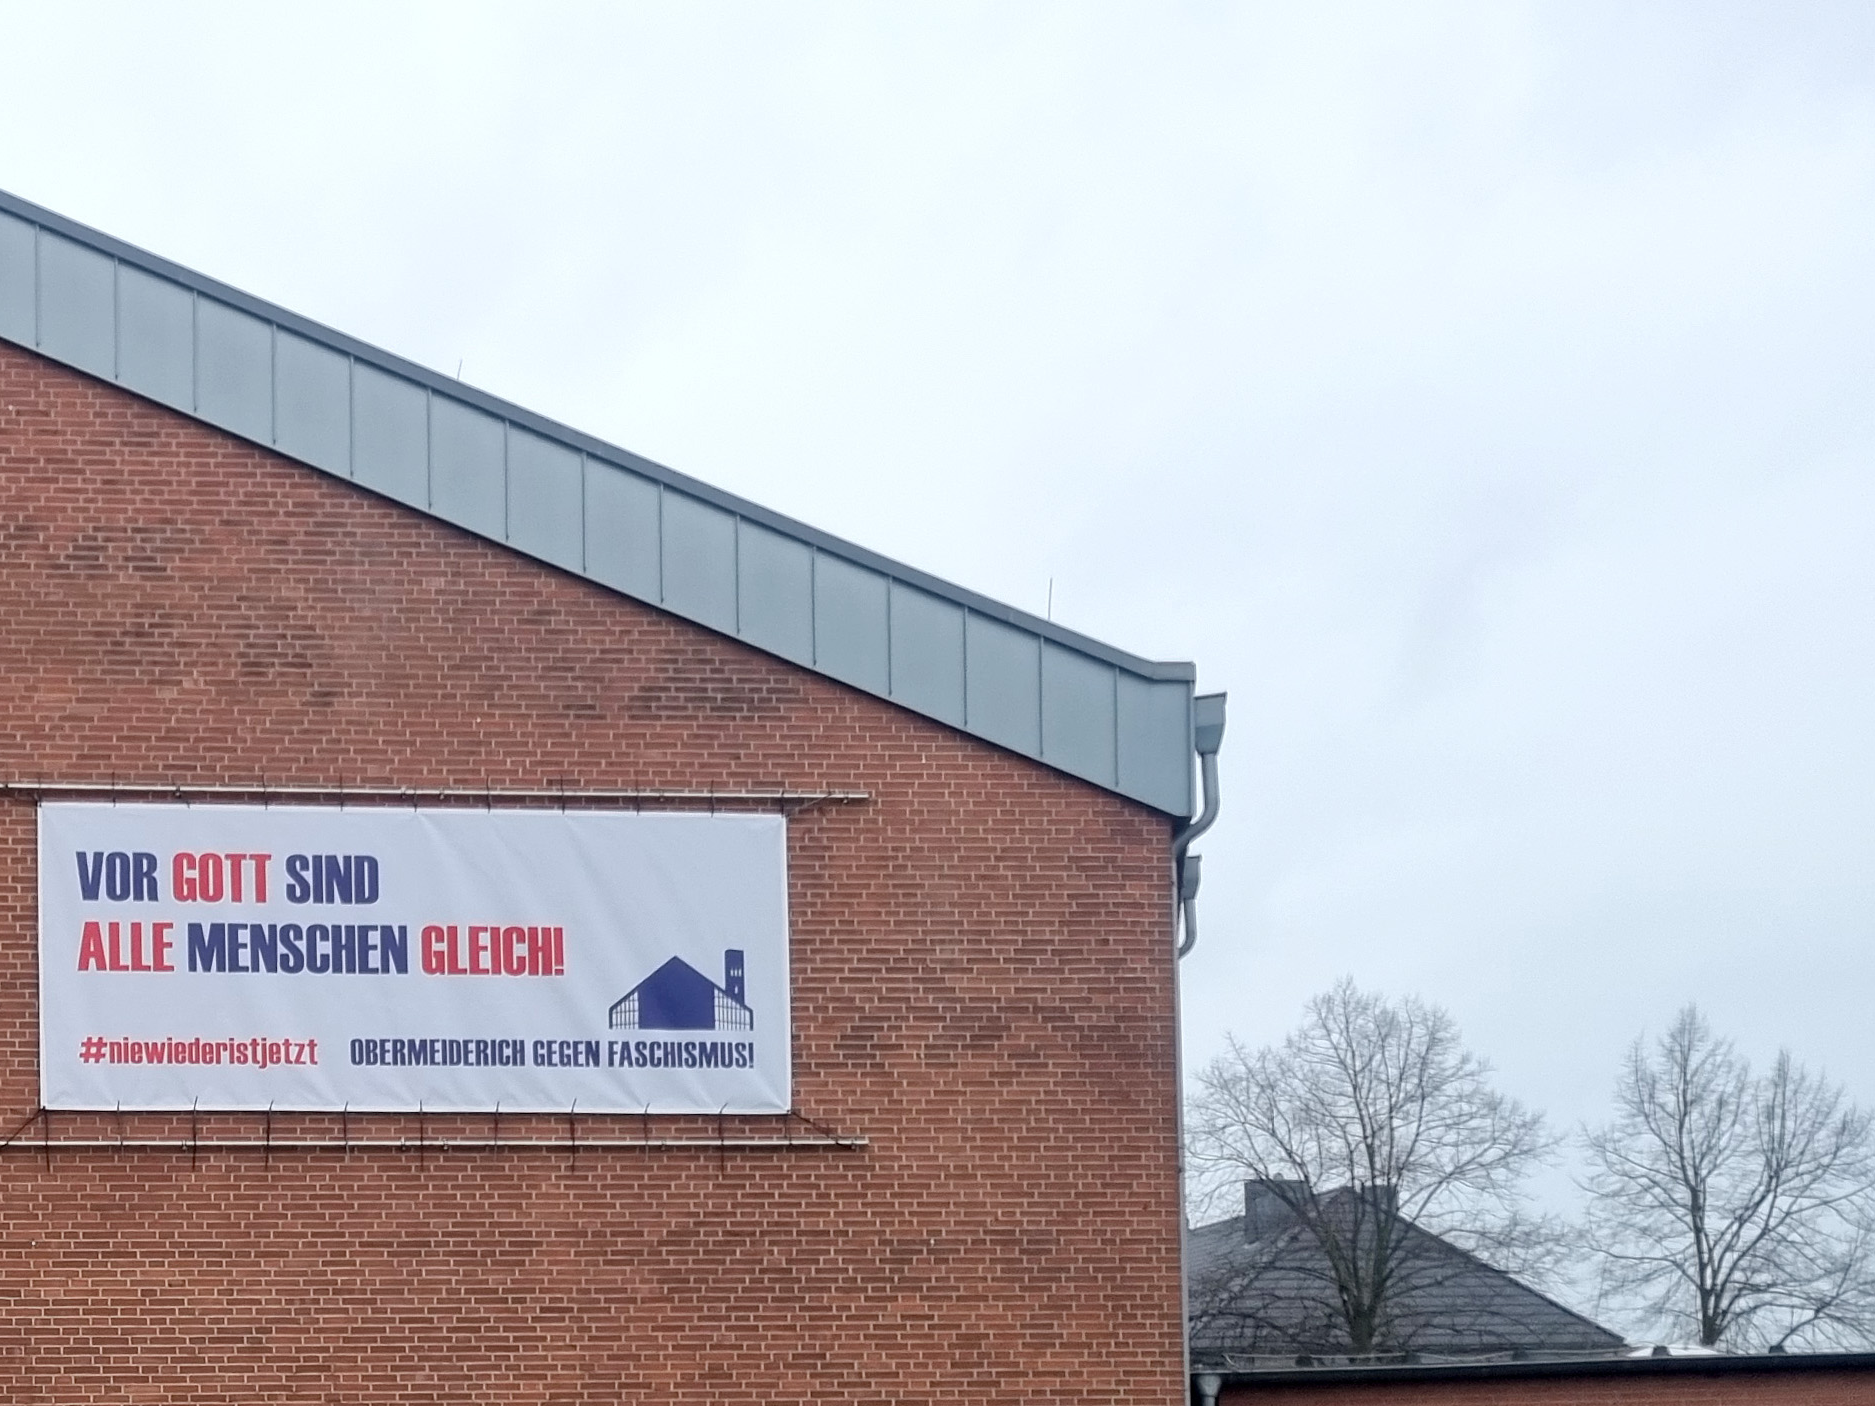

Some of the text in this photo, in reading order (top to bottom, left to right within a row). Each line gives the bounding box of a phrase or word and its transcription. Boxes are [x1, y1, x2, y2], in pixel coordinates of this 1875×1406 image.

[75, 851, 380, 905] VOR GOTT SIND
[77, 921, 565, 977] ALLE MENSCHEN GLEICH!
[79, 1036, 318, 1069] #niewiederistjetzt
[350, 1038, 754, 1069] OBERMEIDERICH GEGEN FASCHISMUS!
